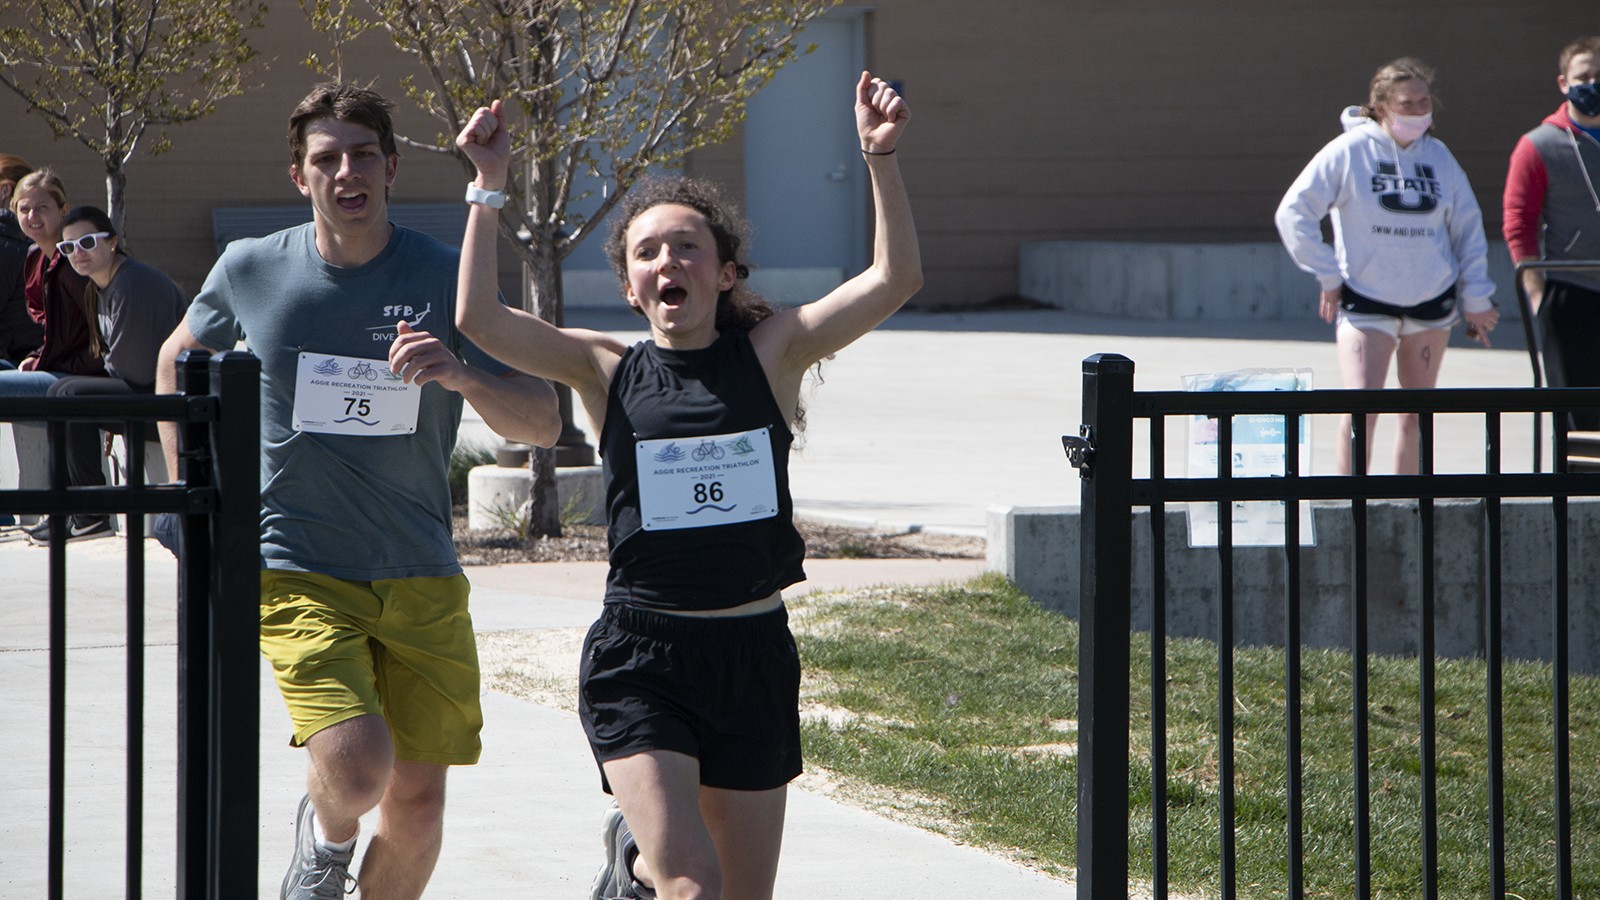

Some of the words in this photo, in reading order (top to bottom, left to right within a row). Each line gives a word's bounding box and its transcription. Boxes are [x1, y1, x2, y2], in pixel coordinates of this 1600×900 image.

[1371, 174, 1441, 199] STATE
[1372, 224, 1392, 235] SWIM
[1394, 226, 1409, 236] AND
[1410, 227, 1426, 237] DIVE
[383, 304, 414, 317] SFB
[372, 332, 395, 341] DIVE
[1421, 344, 1431, 369] 9
[310, 379, 330, 387] AGGIE
[331, 381, 372, 390] RECREATION
[344, 397, 371, 417] 75
[653, 468, 675, 476] AGGIE
[676, 464, 721, 474] RECREATION
[722, 459, 760, 470] TRIATHLON
[693, 481, 724, 504] 86
